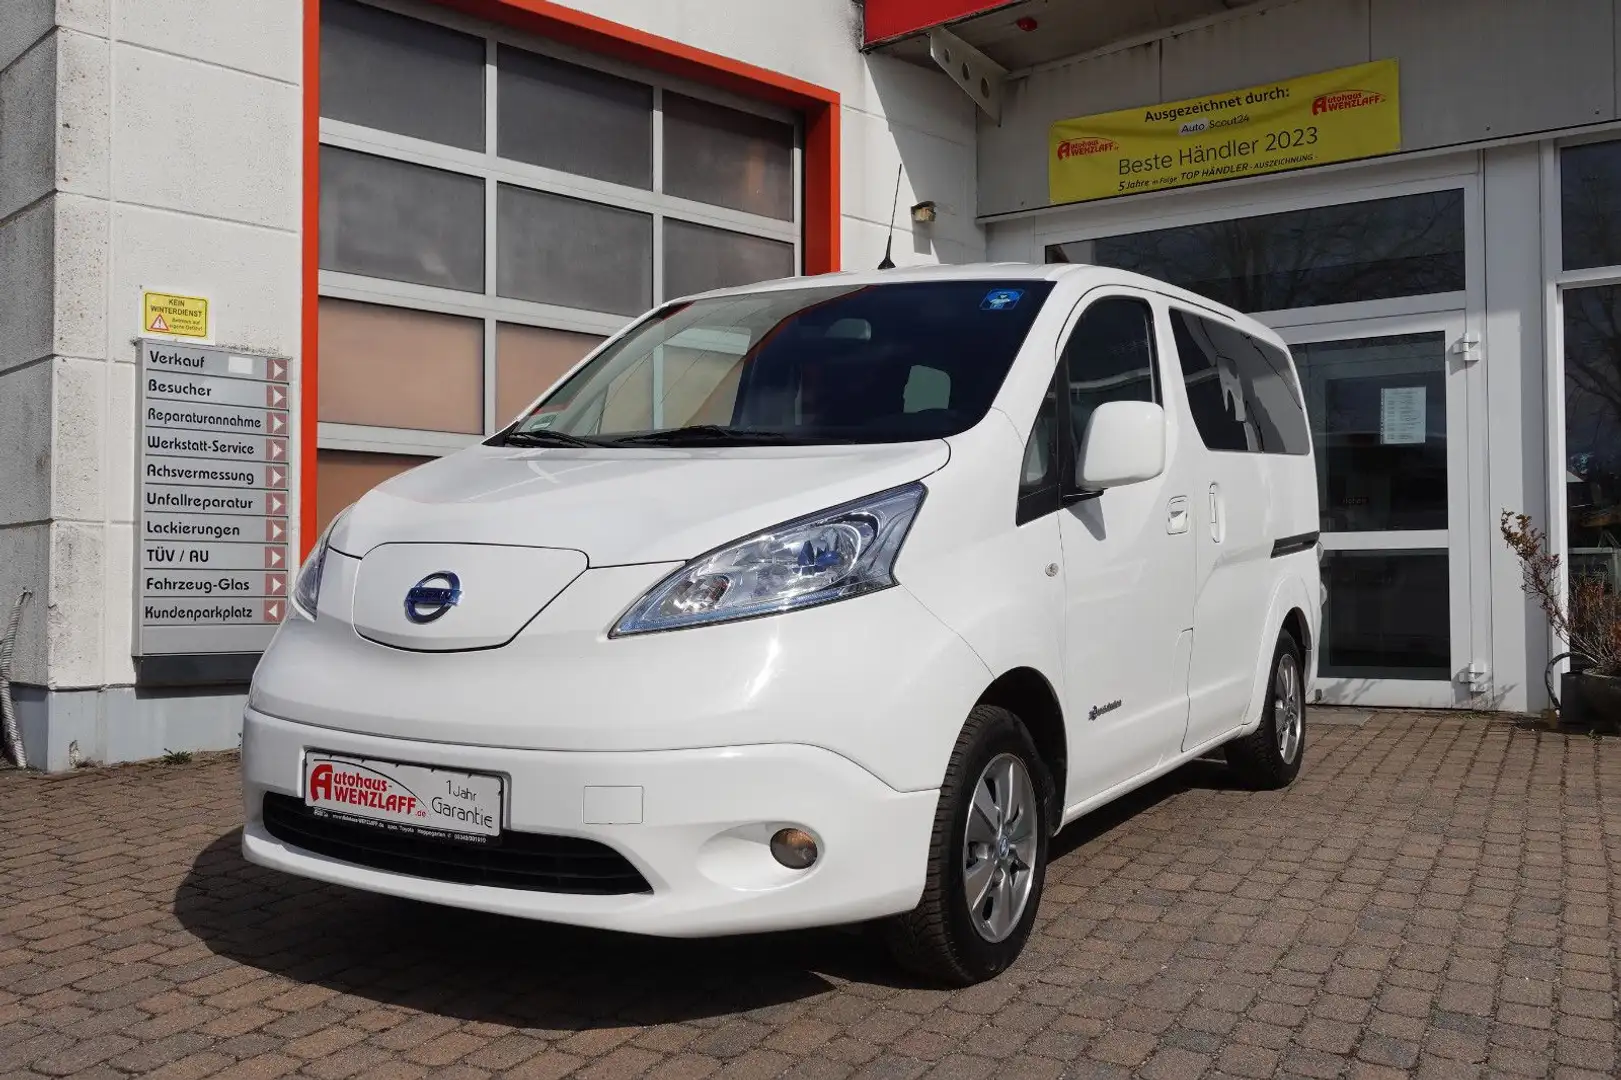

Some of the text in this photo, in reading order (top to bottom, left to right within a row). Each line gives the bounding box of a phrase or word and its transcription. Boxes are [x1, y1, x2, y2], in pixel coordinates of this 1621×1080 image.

[1144, 86, 1290, 122] Ausgezeichnet durch:
[1328, 95, 1380, 111] WENZLAFF
[1181, 114, 1250, 133] Auto Scout24
[1119, 126, 1318, 175] Beste Händler 2023
[1117, 181, 1126, 192] 5
[1126, 179, 1150, 189] Jahre
[1181, 170, 1200, 181] TOP
[1201, 163, 1249, 178] HÄNDLER
[1254, 153, 1314, 169] AUSZEICHNUNG
[150, 305, 202, 318] WINTERDIENST
[168, 299, 185, 307] KEIN
[150, 351, 205, 368] Verkauf
[148, 379, 212, 397] Besucher
[148, 408, 262, 428] Reparaturannahme
[147, 435, 255, 455] Werkstatt-Service
[147, 464, 255, 485] Achsvermessung
[147, 492, 253, 511] Unfallreparatur
[147, 521, 240, 539] Lackierungen
[147, 546, 175, 562] TÜV
[189, 550, 209, 563] AU
[146, 577, 250, 594] Fahrzeug-Glas
[145, 606, 253, 621] Kundenparkplatz
[333, 785, 417, 815] WENZLAFF
[446, 780, 477, 801] 1 Jahr
[431, 796, 493, 829] Garantie
